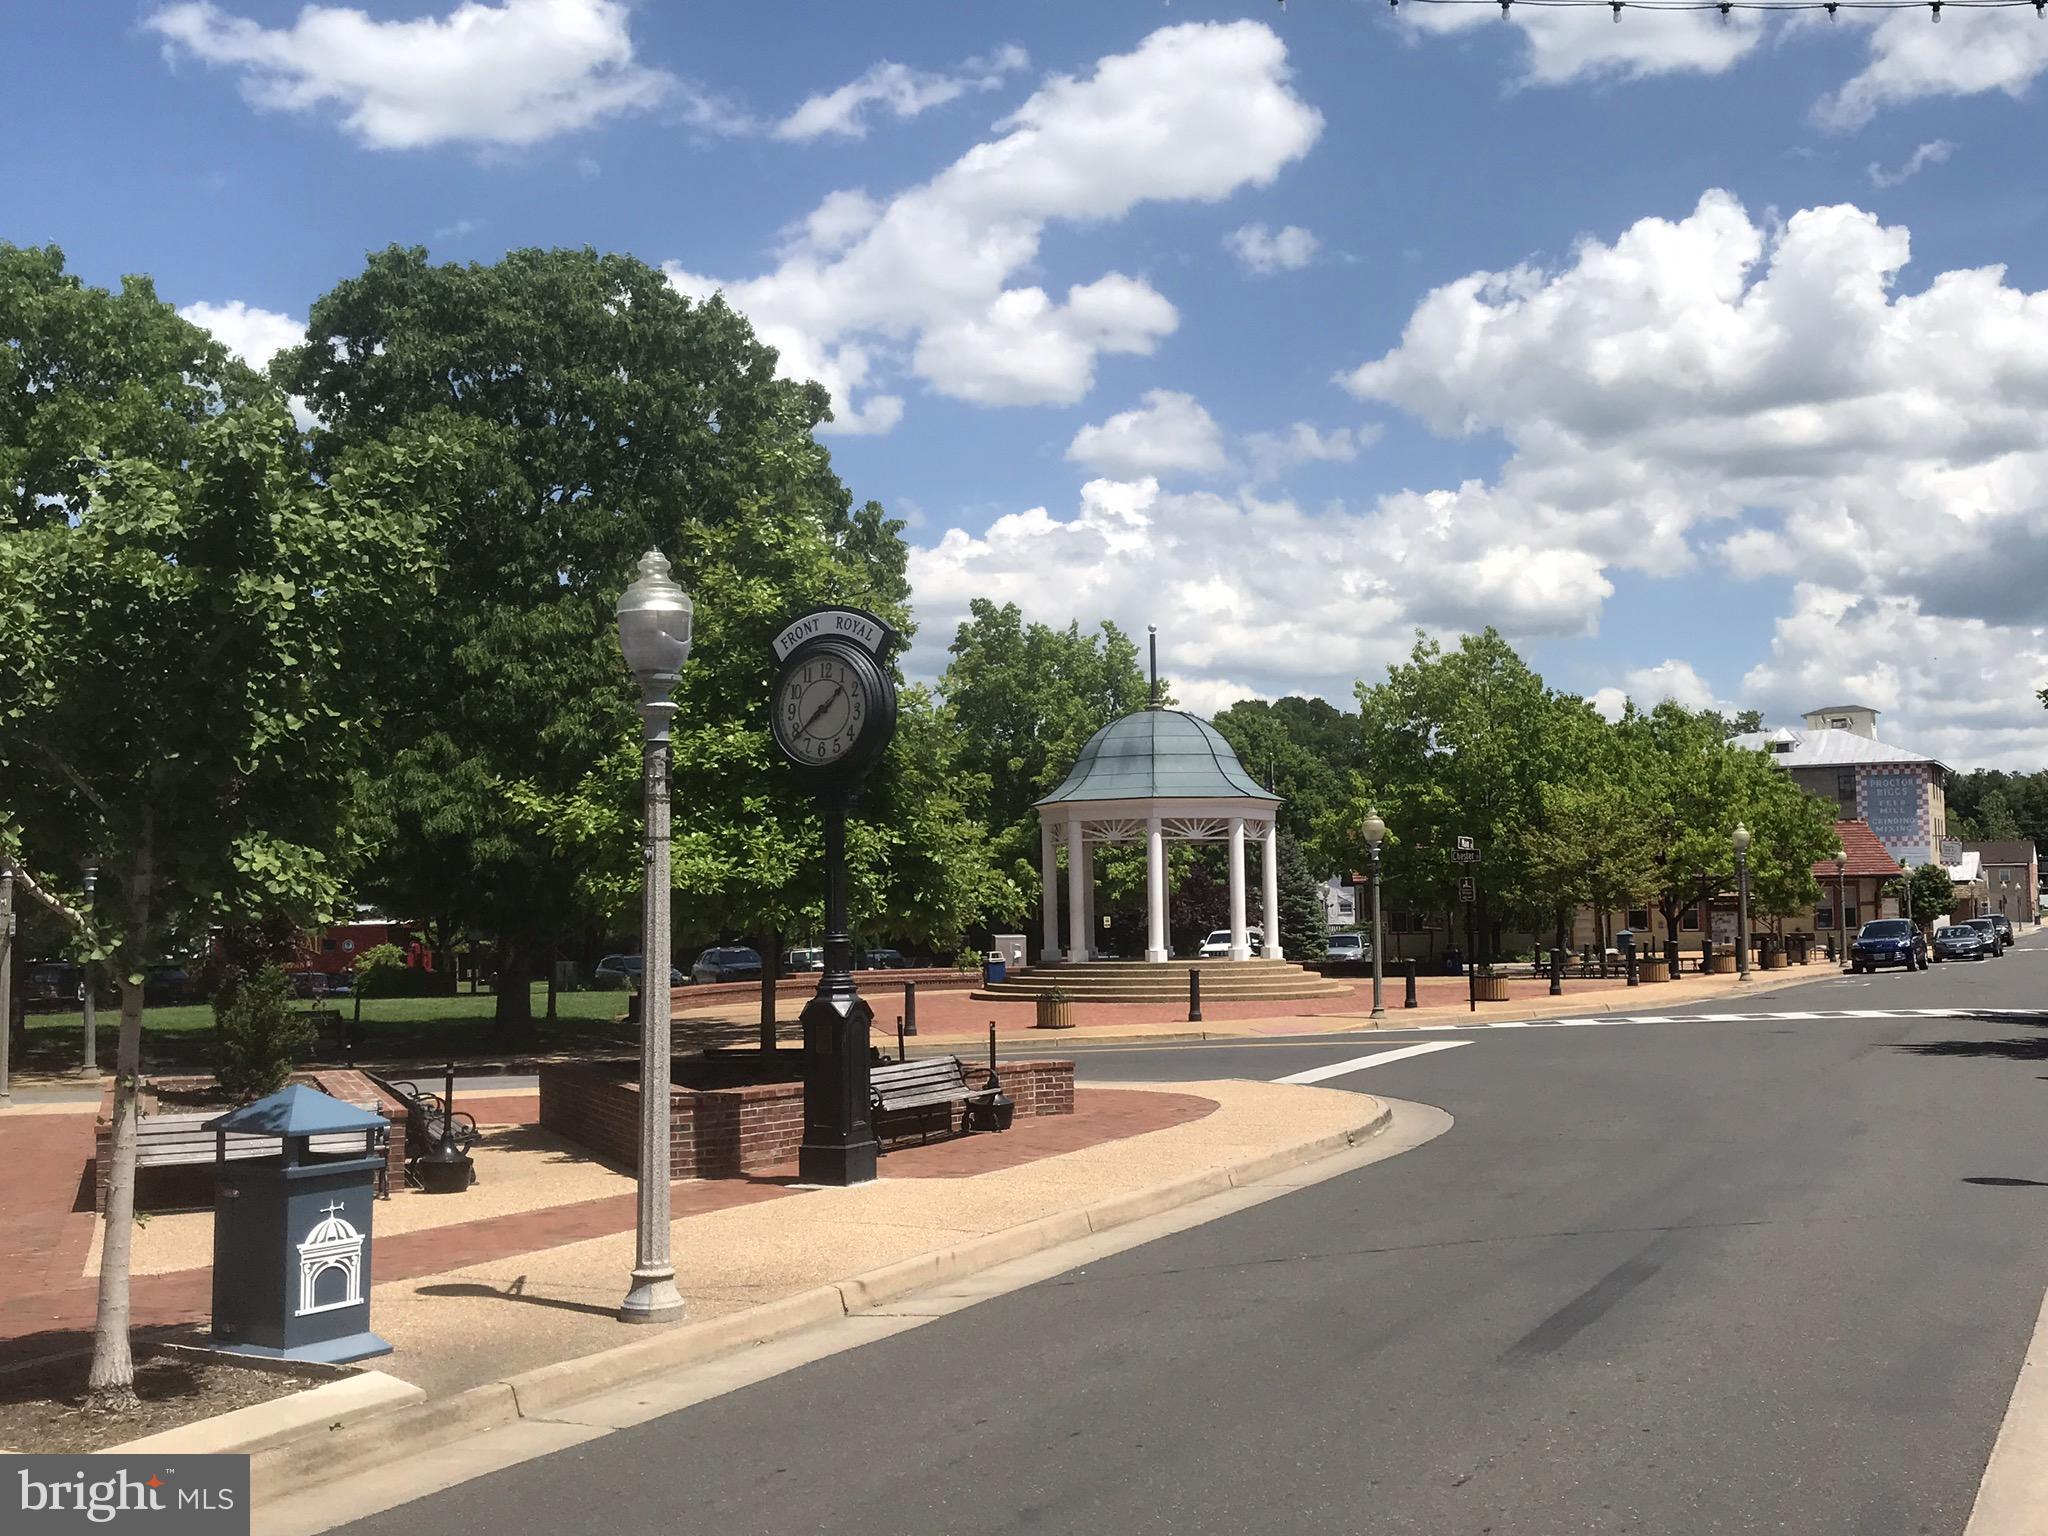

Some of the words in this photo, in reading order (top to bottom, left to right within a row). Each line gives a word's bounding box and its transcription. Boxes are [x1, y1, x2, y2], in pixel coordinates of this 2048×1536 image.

[780, 618, 820, 650] FRONT
[836, 616, 873, 642] ROYAL
[803, 665, 812, 683] 11
[820, 662, 832, 678] 12
[840, 668, 845, 683] 1
[790, 684, 802, 700] 10
[851, 682, 859, 697] 2
[788, 704, 796, 721] 9
[852, 704, 861, 720] 3
[792, 722, 800, 739] 8
[846, 724, 855, 741] 4
[804, 738, 811, 754] 7
[818, 741, 826, 757] 6
[832, 737, 841, 753] 5
[1870, 778, 1913, 787] PROCTOR
[1875, 825, 1912, 833] MIXING
